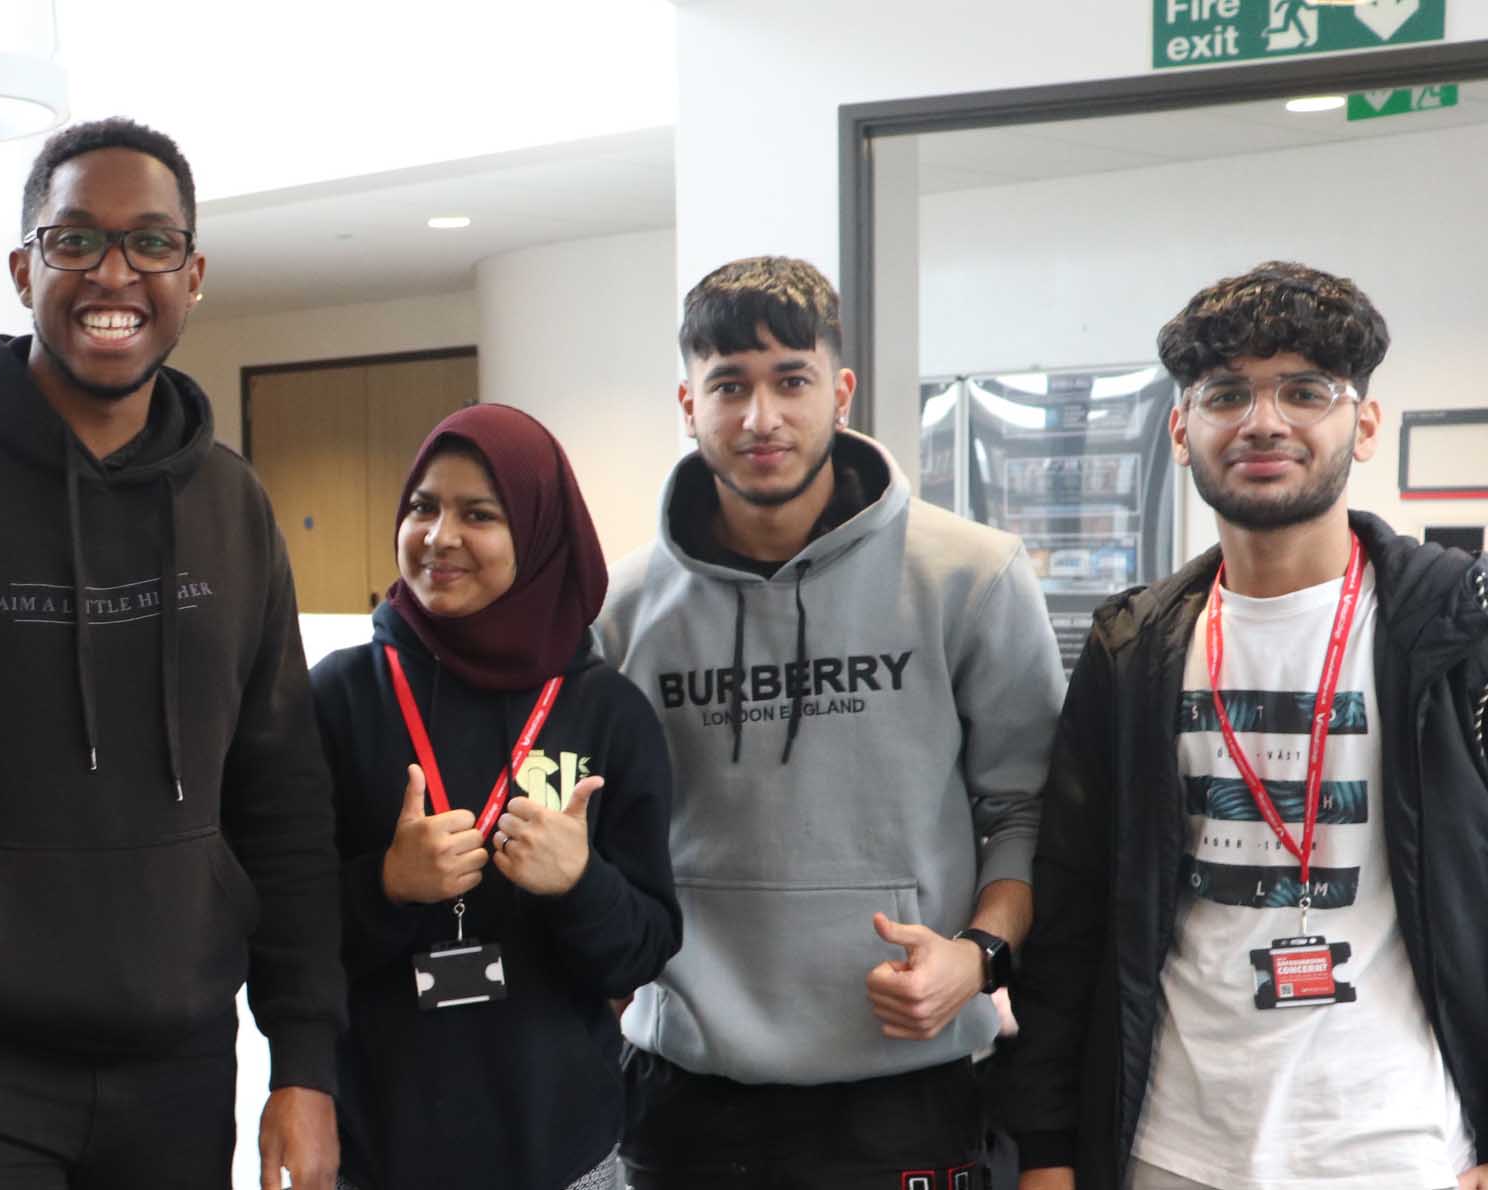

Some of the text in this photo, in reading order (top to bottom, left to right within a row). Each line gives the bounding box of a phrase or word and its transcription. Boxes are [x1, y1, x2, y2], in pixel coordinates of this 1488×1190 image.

[1167, 0, 1240, 24] Fire
[1167, 25, 1240, 61] exit
[42, 598, 56, 613] A
[137, 581, 213, 609] HIHER
[658, 651, 912, 709] BURBERRY
[779, 699, 865, 720] EGLAND
